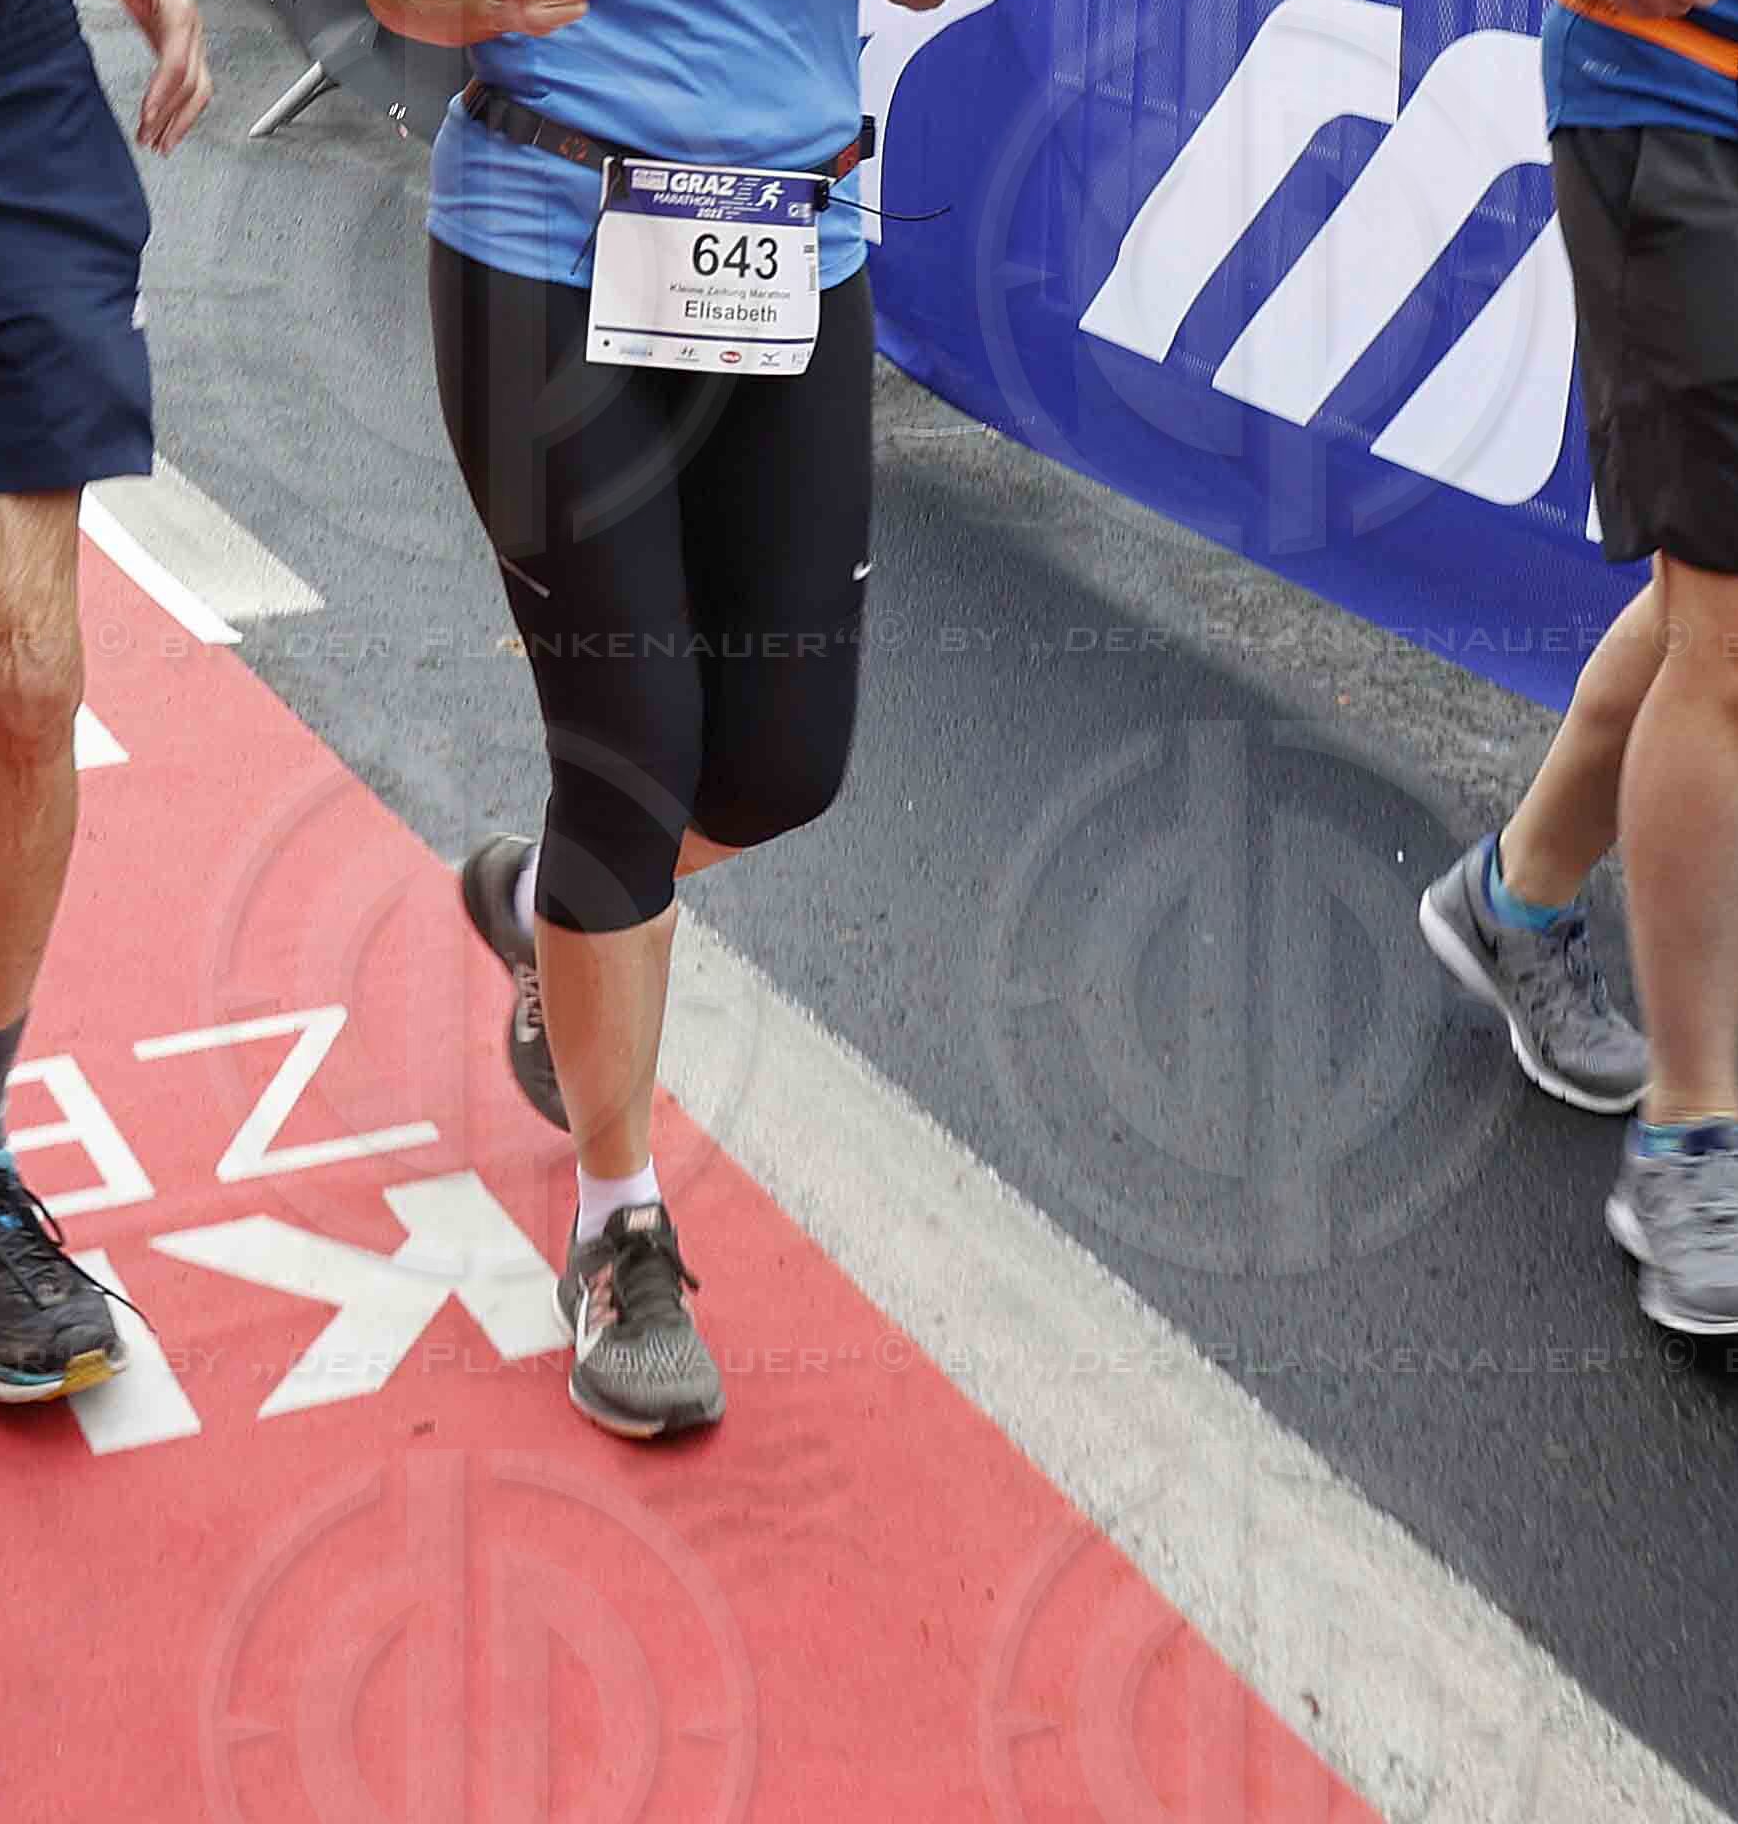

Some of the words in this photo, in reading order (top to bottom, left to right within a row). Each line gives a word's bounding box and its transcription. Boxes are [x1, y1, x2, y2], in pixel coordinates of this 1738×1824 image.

[670, 172, 738, 197] GRAZ
[691, 232, 779, 280] 643
[684, 299, 778, 324] Elisabeth
